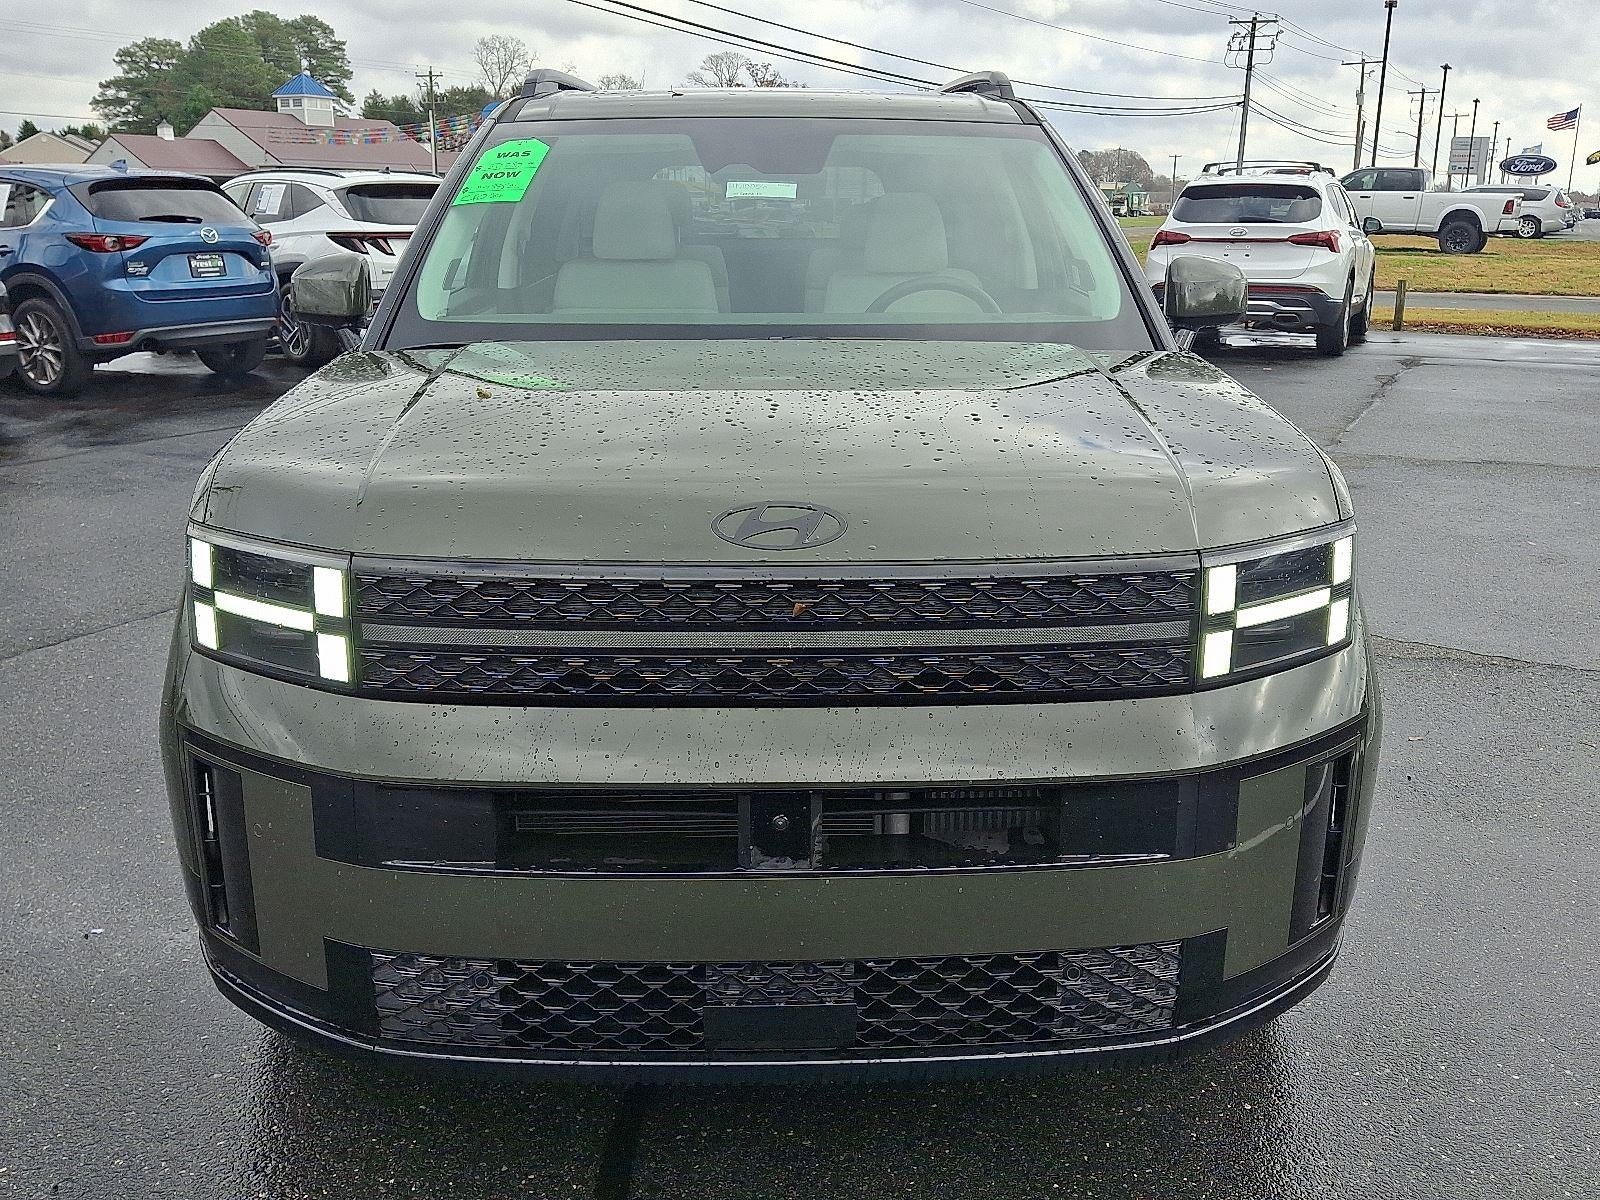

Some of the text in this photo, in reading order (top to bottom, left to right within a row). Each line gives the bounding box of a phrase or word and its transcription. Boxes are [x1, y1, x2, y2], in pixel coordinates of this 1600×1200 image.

[496, 150, 531, 158] WAS
[1510, 159, 1546, 172] Ford
[481, 171, 522, 179] NOW
